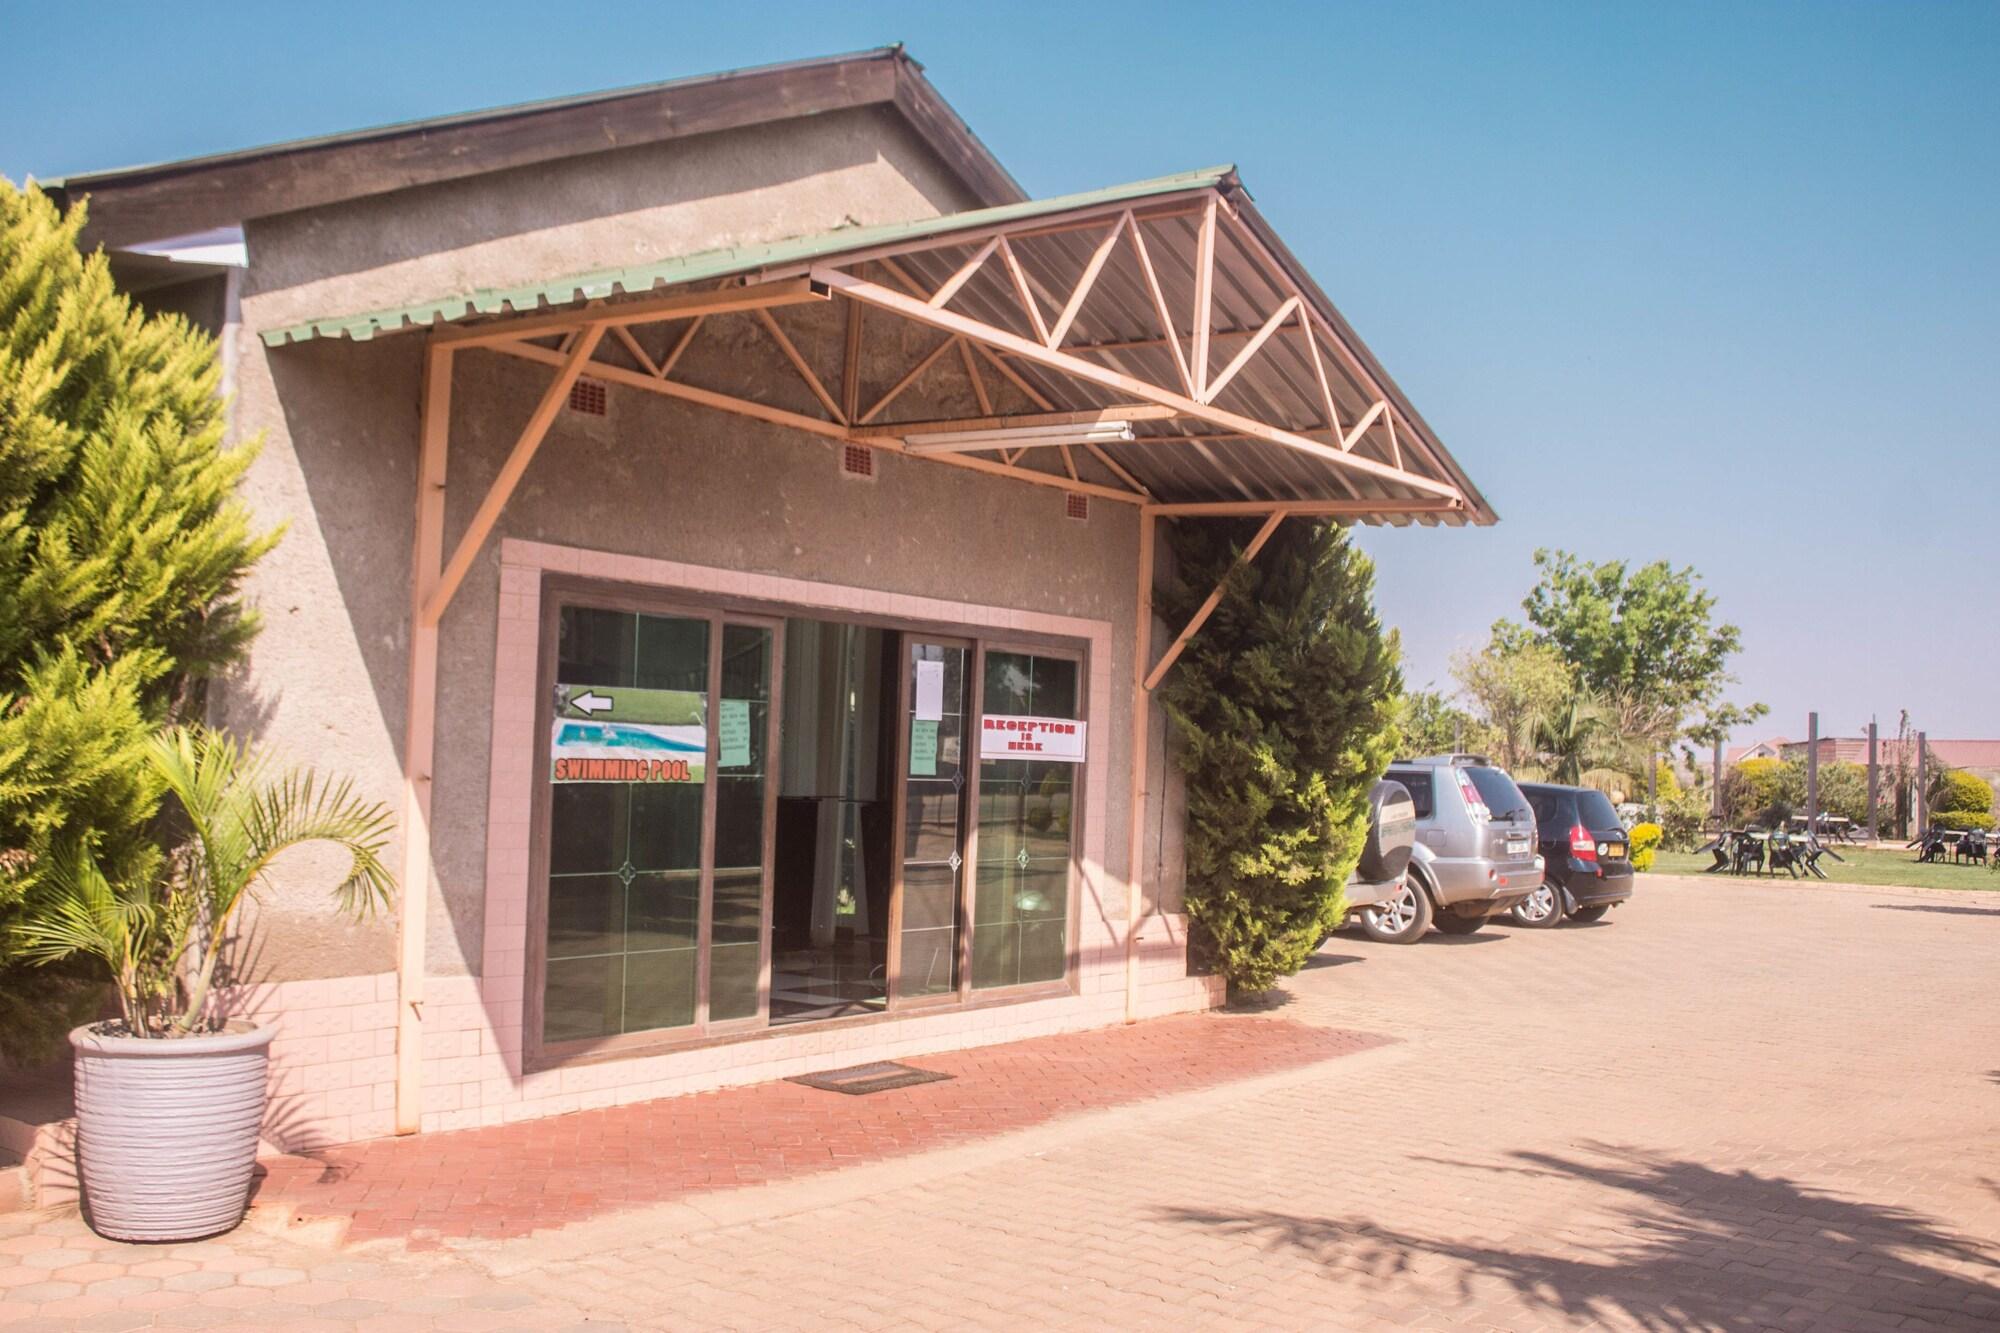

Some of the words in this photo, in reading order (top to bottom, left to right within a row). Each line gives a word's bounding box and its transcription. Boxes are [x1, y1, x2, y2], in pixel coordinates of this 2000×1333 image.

[983, 719, 1075, 734] RECEPTION
[1021, 733, 1032, 741] IS
[1008, 741, 1043, 751] HERE
[555, 758, 649, 781] SWIMMING
[651, 760, 690, 781] POOL
